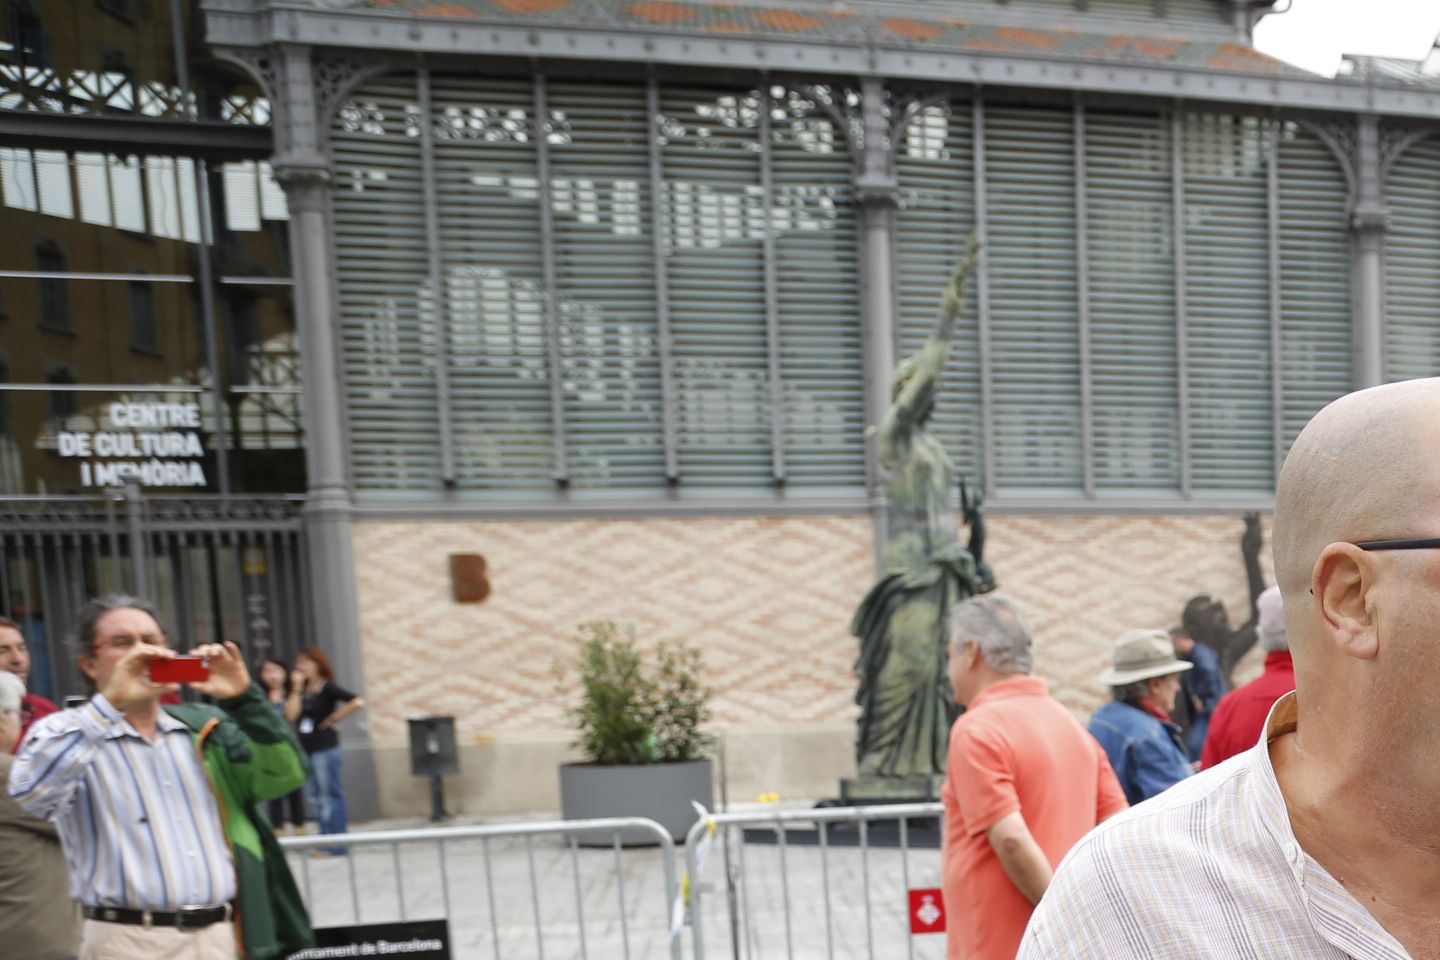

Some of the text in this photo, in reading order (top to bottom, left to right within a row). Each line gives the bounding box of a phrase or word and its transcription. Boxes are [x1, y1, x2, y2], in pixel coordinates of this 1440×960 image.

[110, 402, 200, 427] CENTRE
[58, 432, 205, 457] DE CULTURA
[81, 461, 92, 487] I
[376, 938, 443, 954] Barcelona
